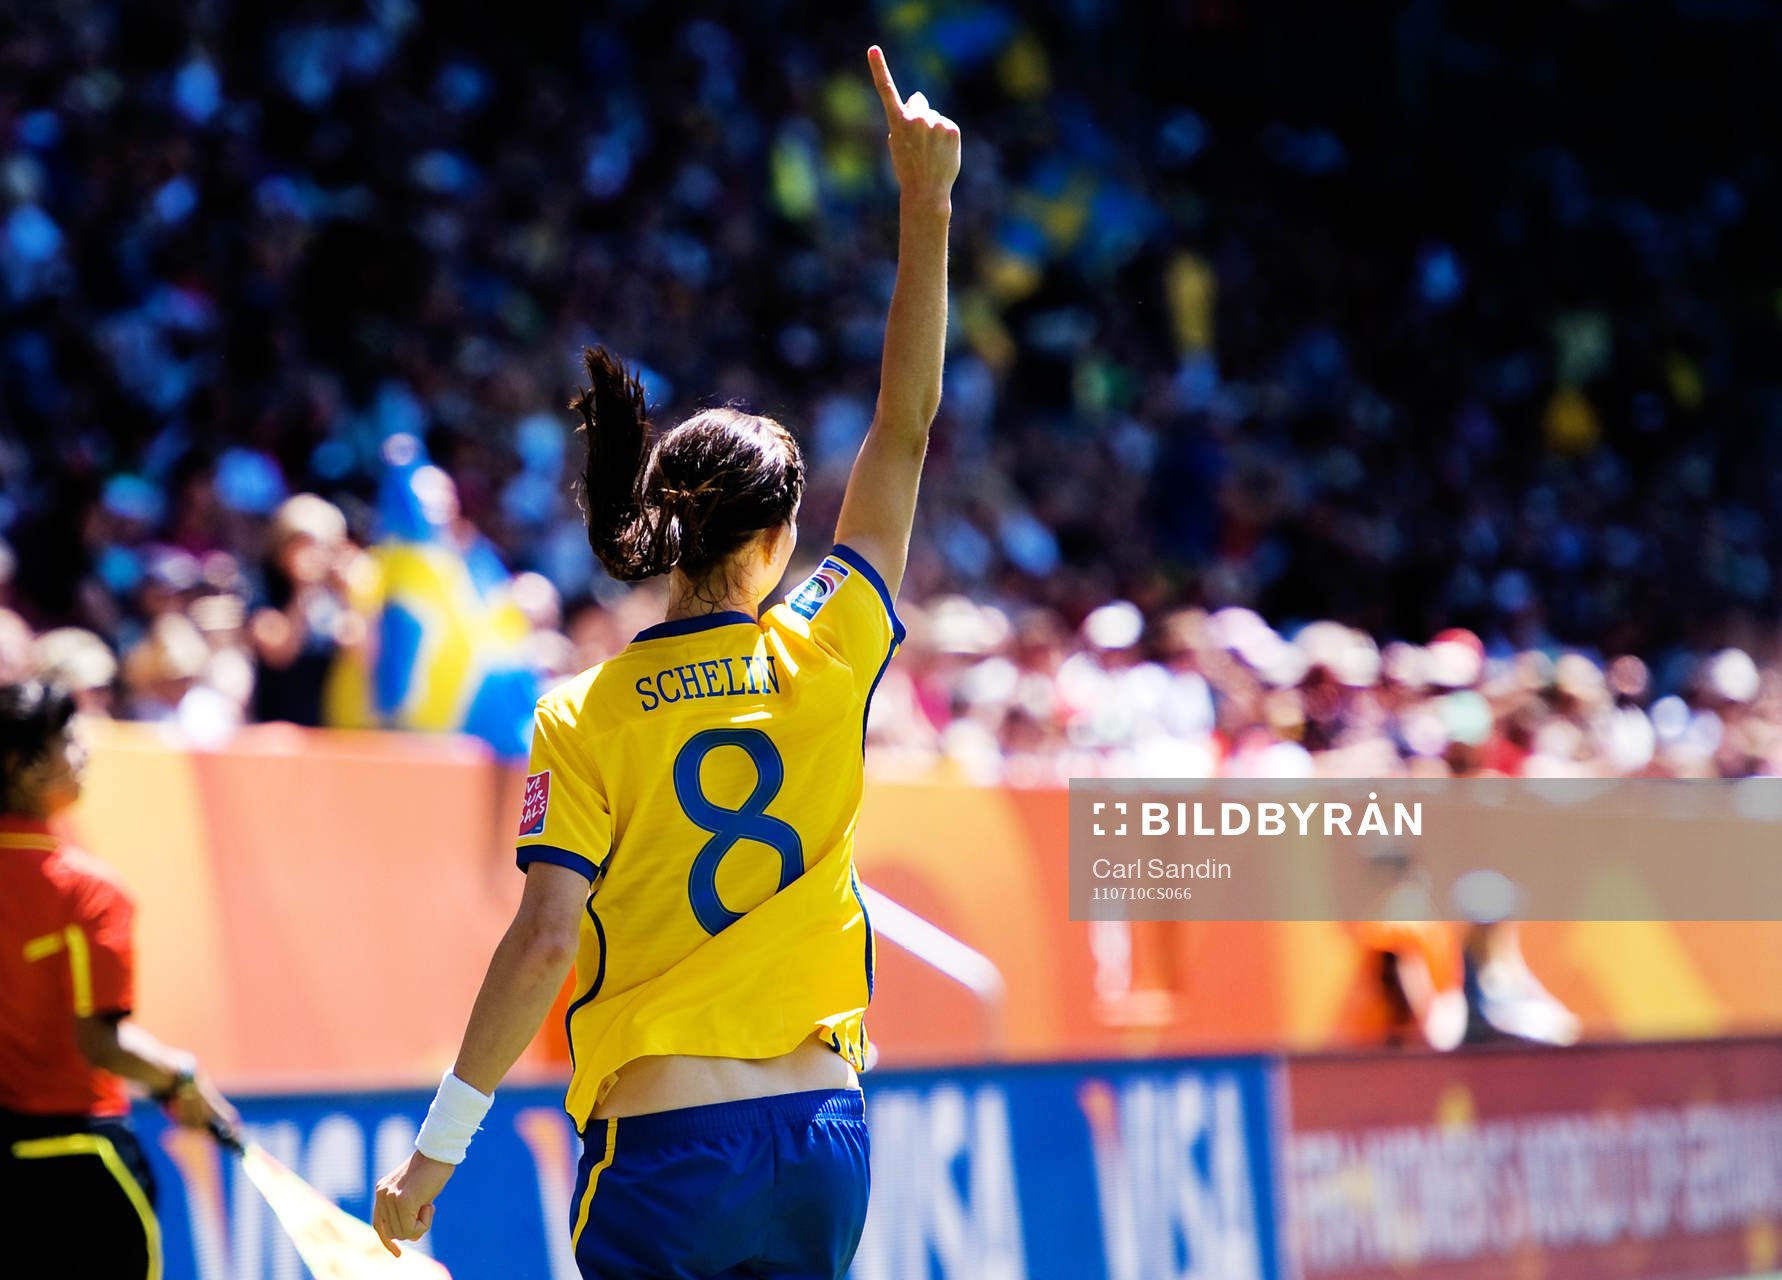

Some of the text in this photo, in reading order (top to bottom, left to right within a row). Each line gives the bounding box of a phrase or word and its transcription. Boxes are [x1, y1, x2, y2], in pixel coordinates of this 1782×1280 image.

[635, 655, 781, 712] SCHELIN
[527, 776, 541, 794] VE
[672, 727, 805, 937] 8
